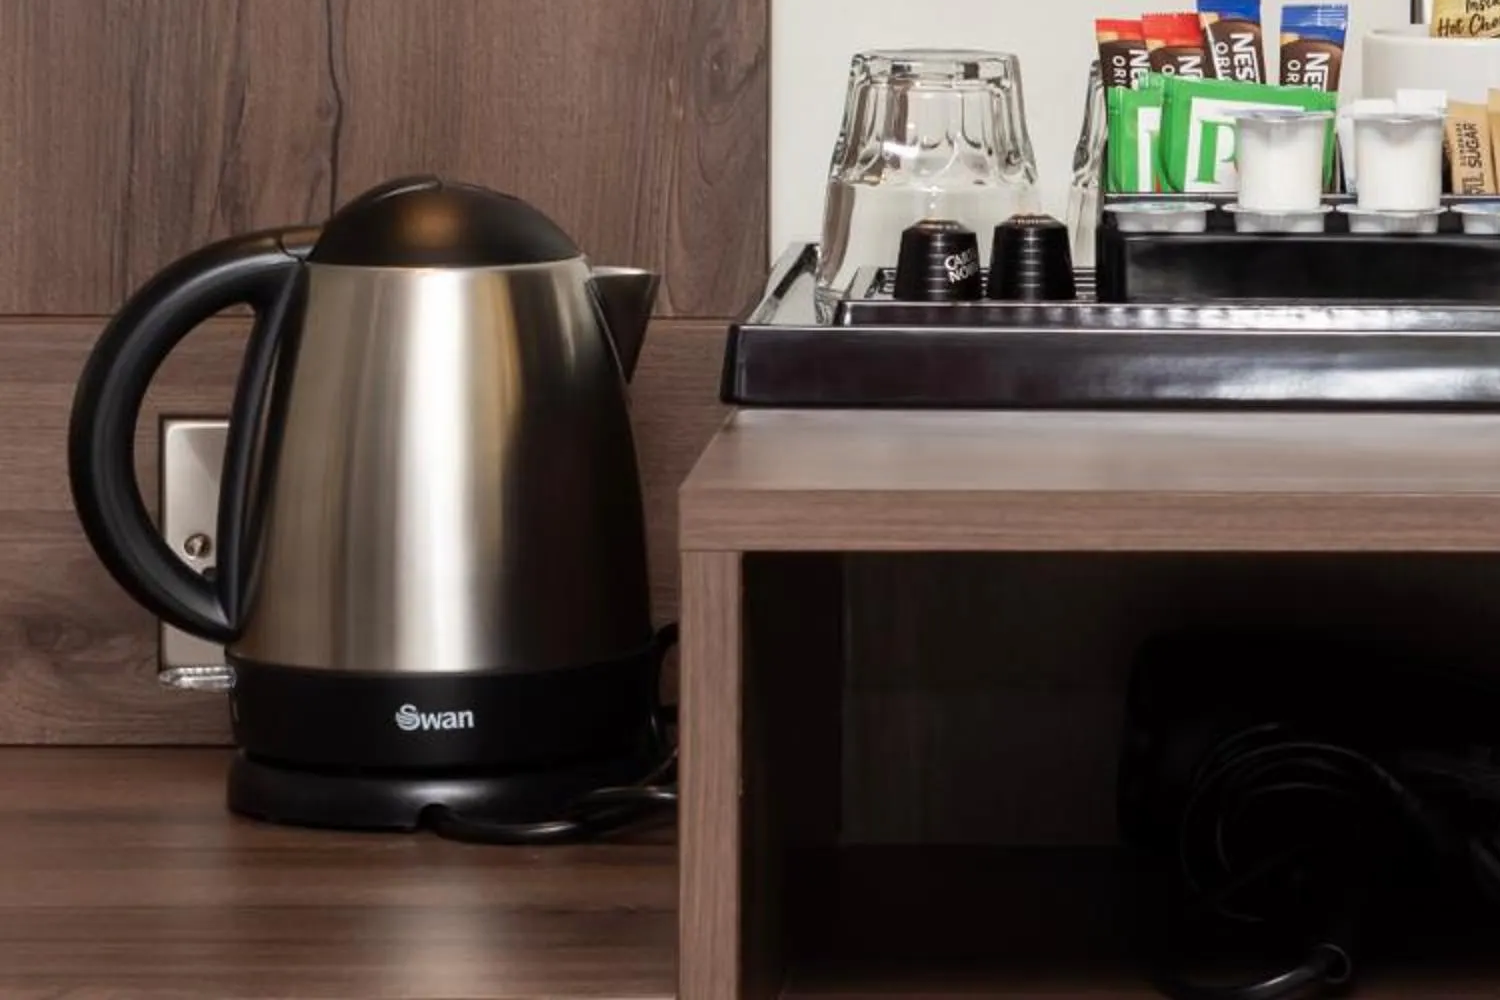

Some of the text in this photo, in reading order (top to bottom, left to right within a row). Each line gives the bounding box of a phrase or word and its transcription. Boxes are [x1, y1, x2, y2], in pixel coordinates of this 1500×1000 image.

[1437, 17, 1464, 37] Hot
[1112, 55, 1127, 87] ORI
[1215, 41, 1232, 80] ORI
[1463, 123, 1482, 168] SUGAR
[395, 704, 474, 731] Swan
